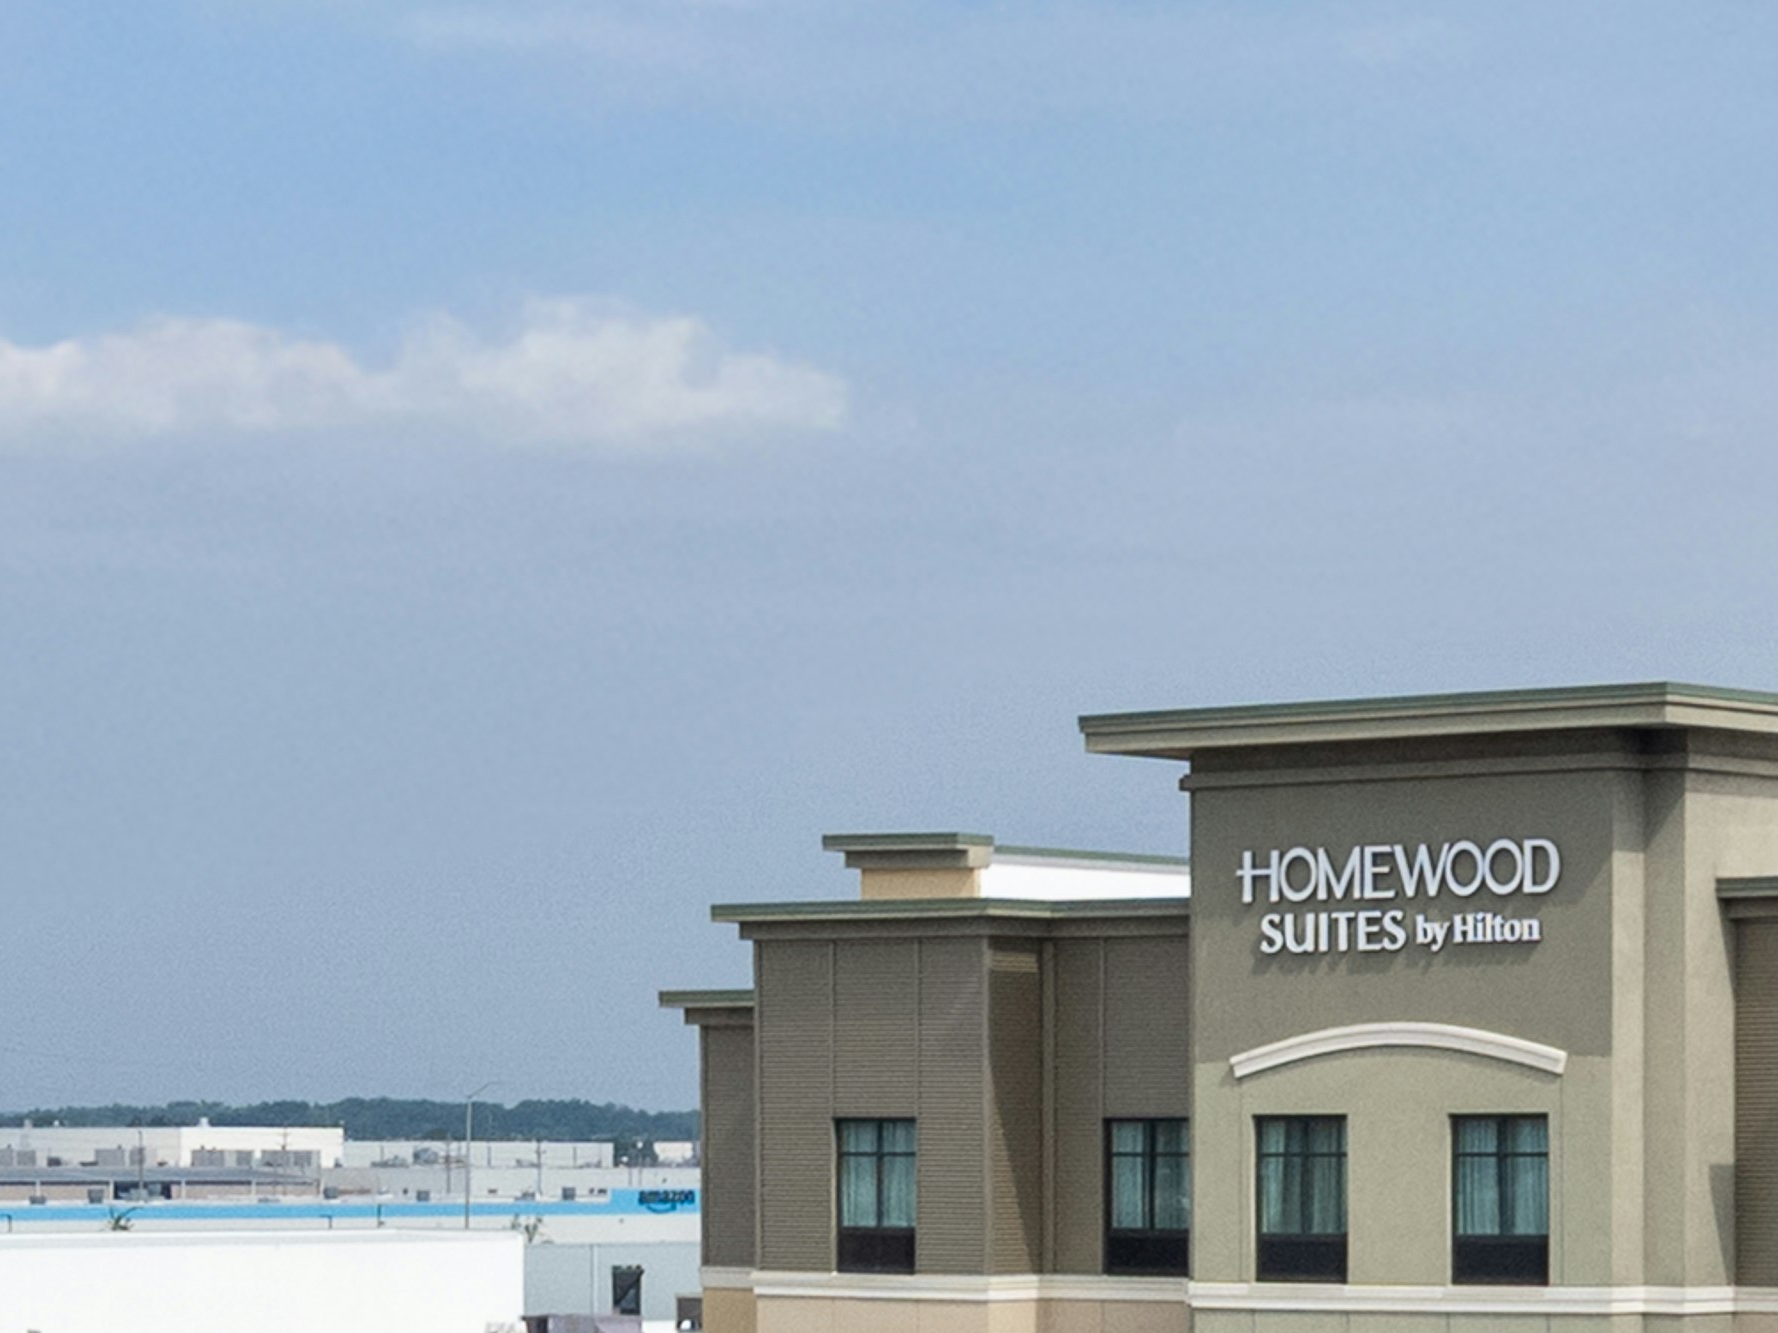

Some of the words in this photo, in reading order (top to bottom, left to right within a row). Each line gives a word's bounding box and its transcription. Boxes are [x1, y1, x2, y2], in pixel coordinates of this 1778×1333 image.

[1235, 839, 1562, 904] HOMEWOOD
[1259, 910, 1407, 954] SUITES
[1415, 914, 1451, 952] by
[1452, 912, 1541, 945] Hilton
